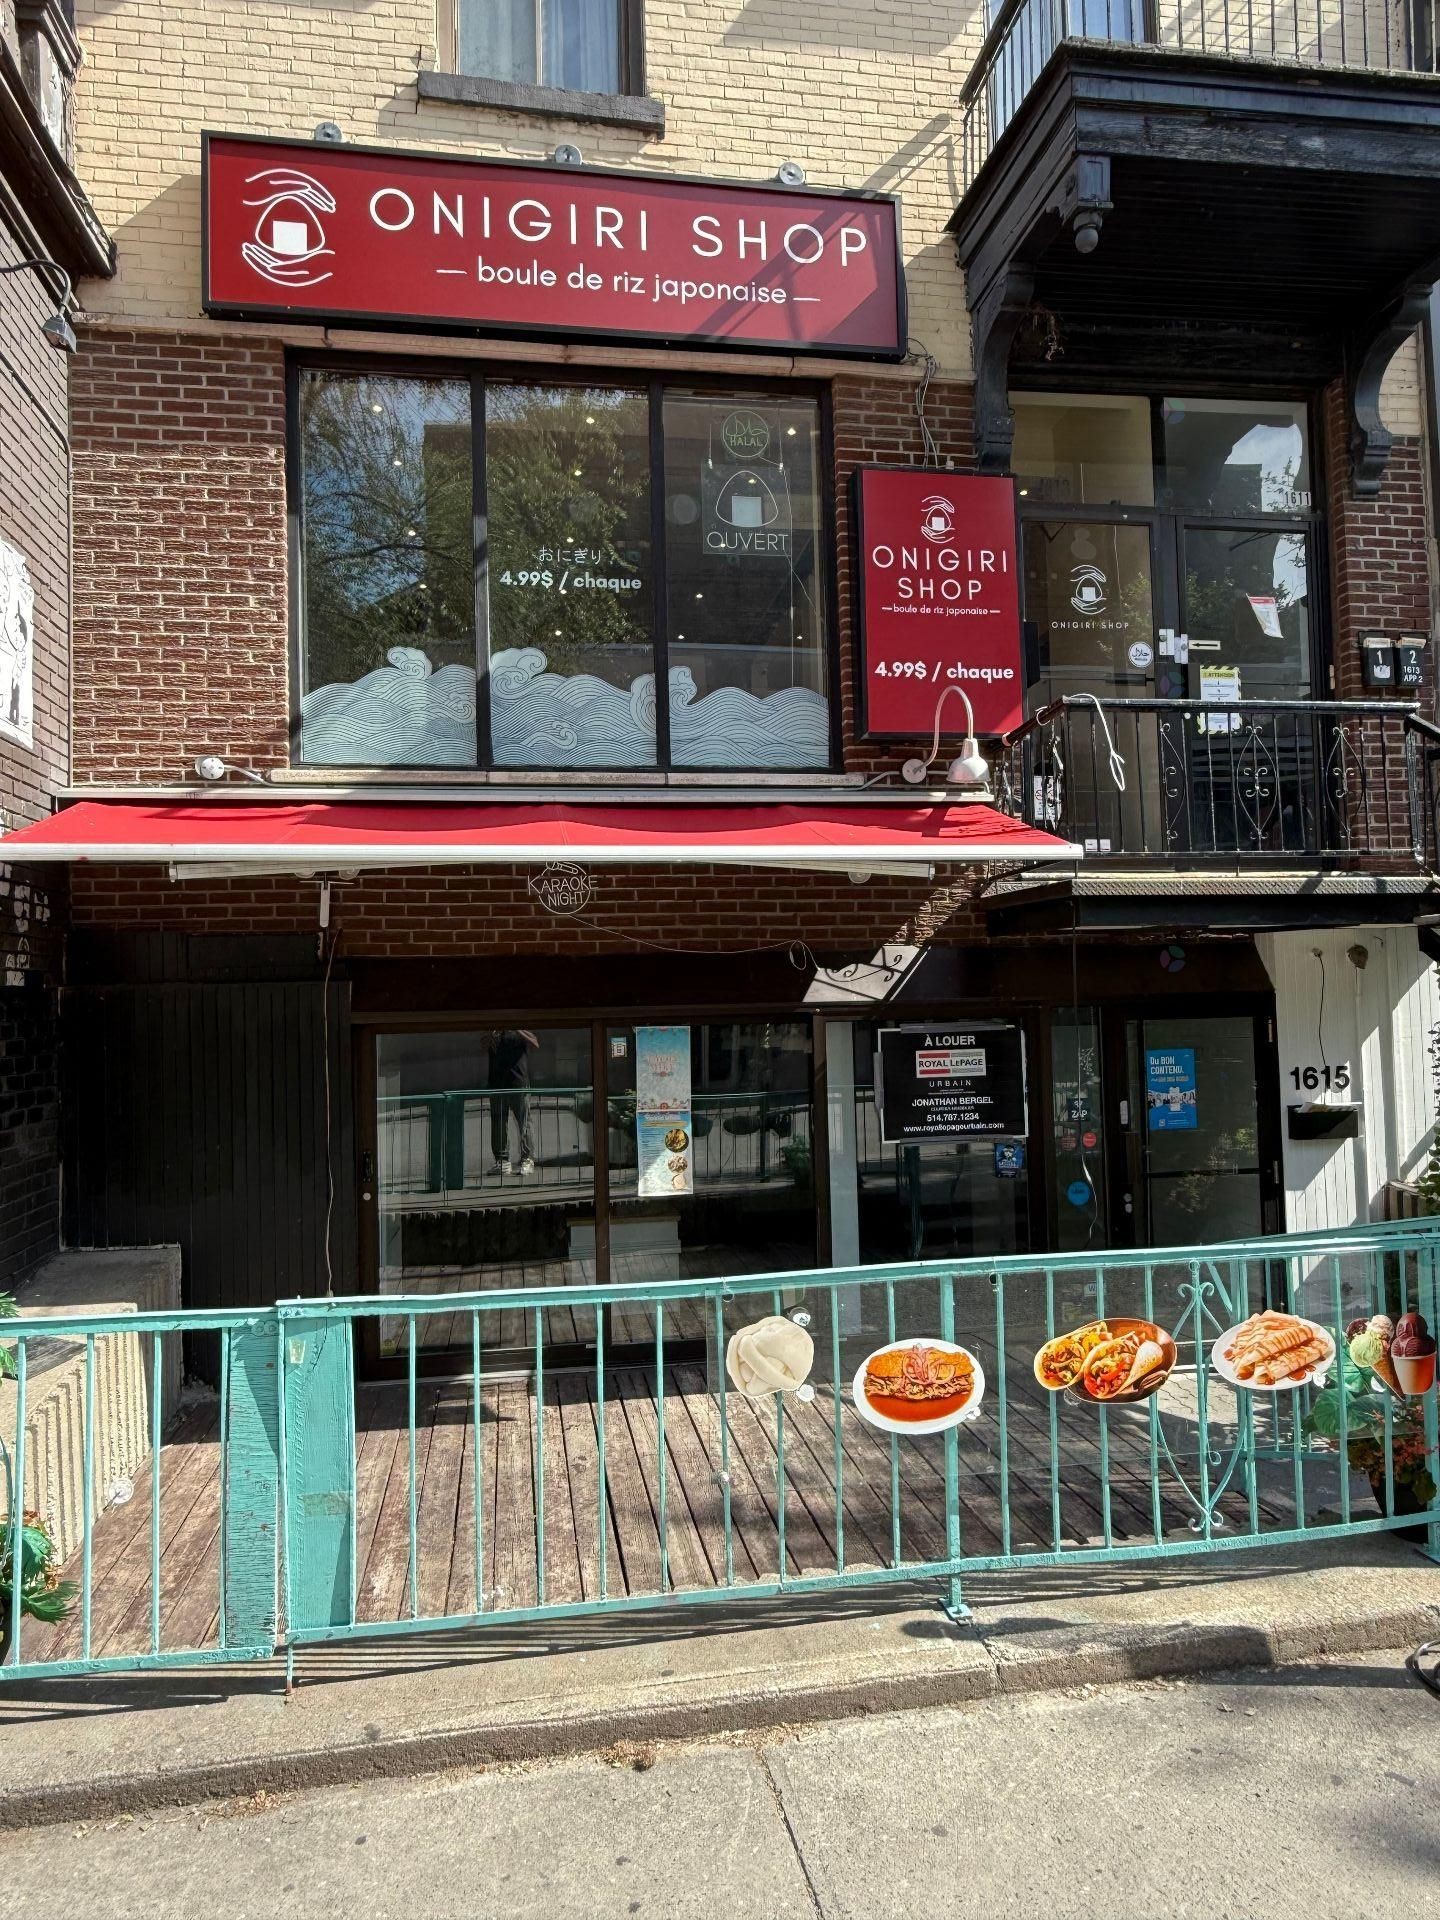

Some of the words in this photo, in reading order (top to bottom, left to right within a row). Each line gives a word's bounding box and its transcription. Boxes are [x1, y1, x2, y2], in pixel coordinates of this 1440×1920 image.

[370, 187, 647, 251] ONIGIRI
[692, 215, 868, 267] SHOP
[477, 256, 557, 288] boule
[566, 257, 602, 290] de
[612, 266, 645, 294] riz
[652, 272, 787, 305] japonaise
[730, 436, 763, 447] HALAL
[1284, 491, 1309, 507] 1611
[706, 531, 789, 550] OUVERT
[538, 546, 602, 565] おにぎり
[872, 545, 1007, 573] ONIGIRI
[499, 570, 553, 589] 4.99$
[559, 571, 569, 590] /
[573, 572, 642, 593] chaque
[898, 577, 982, 600] SHOP
[893, 603, 918, 613] boule
[920, 604, 931, 614] de
[933, 605, 944, 614] riz
[946, 606, 988, 616] japonaise
[1051, 621, 1095, 629] ONIGIRI
[1377, 650, 1383, 664] 1
[1409, 650, 1417, 664] 2
[874, 660, 927, 680] 4.99$
[931, 661, 942, 682] /
[946, 662, 1014, 684] chaque
[1403, 674, 1417, 682] APP
[1418, 675, 1423, 683] 2
[527, 875, 600, 896] KARAOKE
[547, 890, 586, 908] NIGHT
[924, 1034, 933, 1047] À
[936, 1035, 976, 1047] LOUER
[918, 1059, 949, 1068] ROYAL
[929, 1079, 971, 1088] URBAIN
[1289, 1065, 1350, 1091] 1615
[911, 1097, 958, 1107] JONATHAN
[959, 1096, 994, 1105] BERGEL
